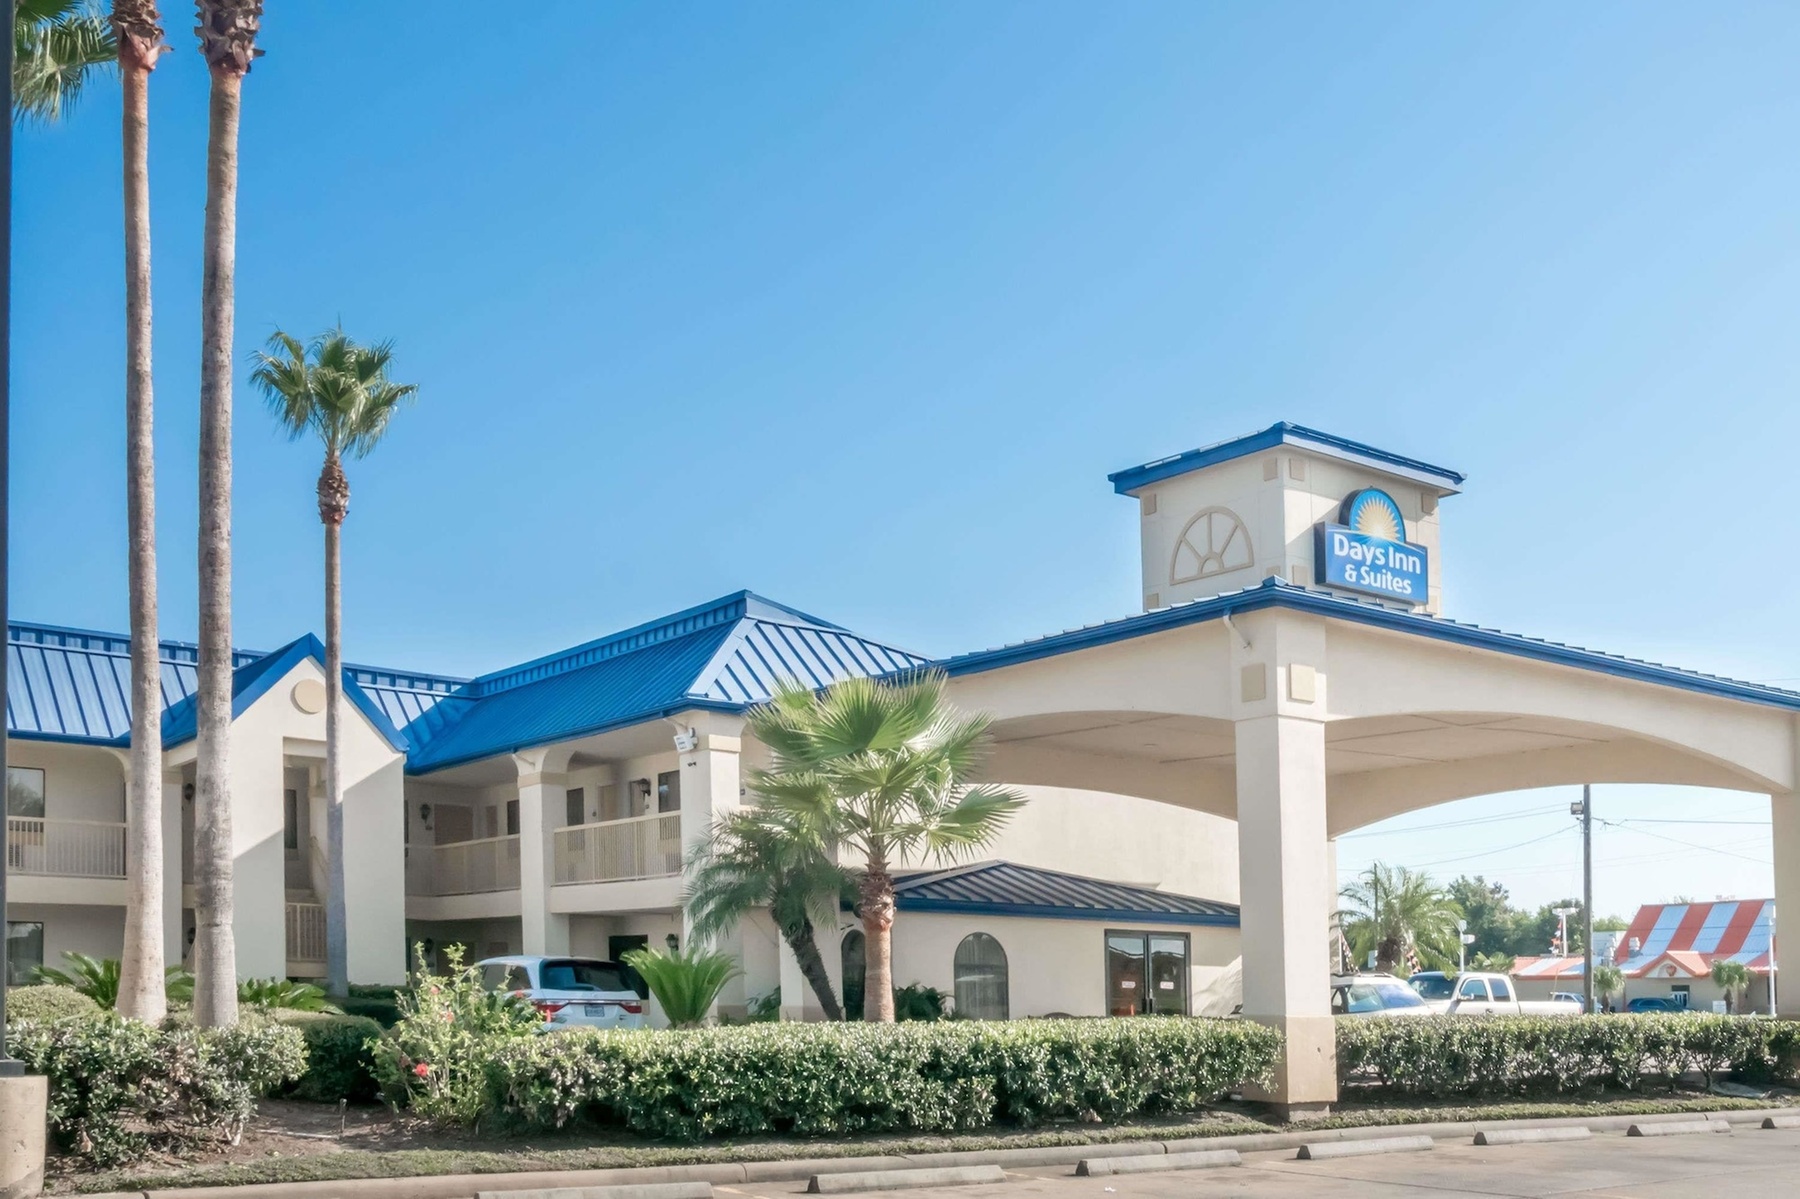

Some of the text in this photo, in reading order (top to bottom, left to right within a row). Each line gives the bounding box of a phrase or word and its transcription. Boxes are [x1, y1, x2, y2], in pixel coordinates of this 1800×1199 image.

[1333, 533, 1421, 575] Days Inn
[1344, 564, 1412, 594] & Suites
